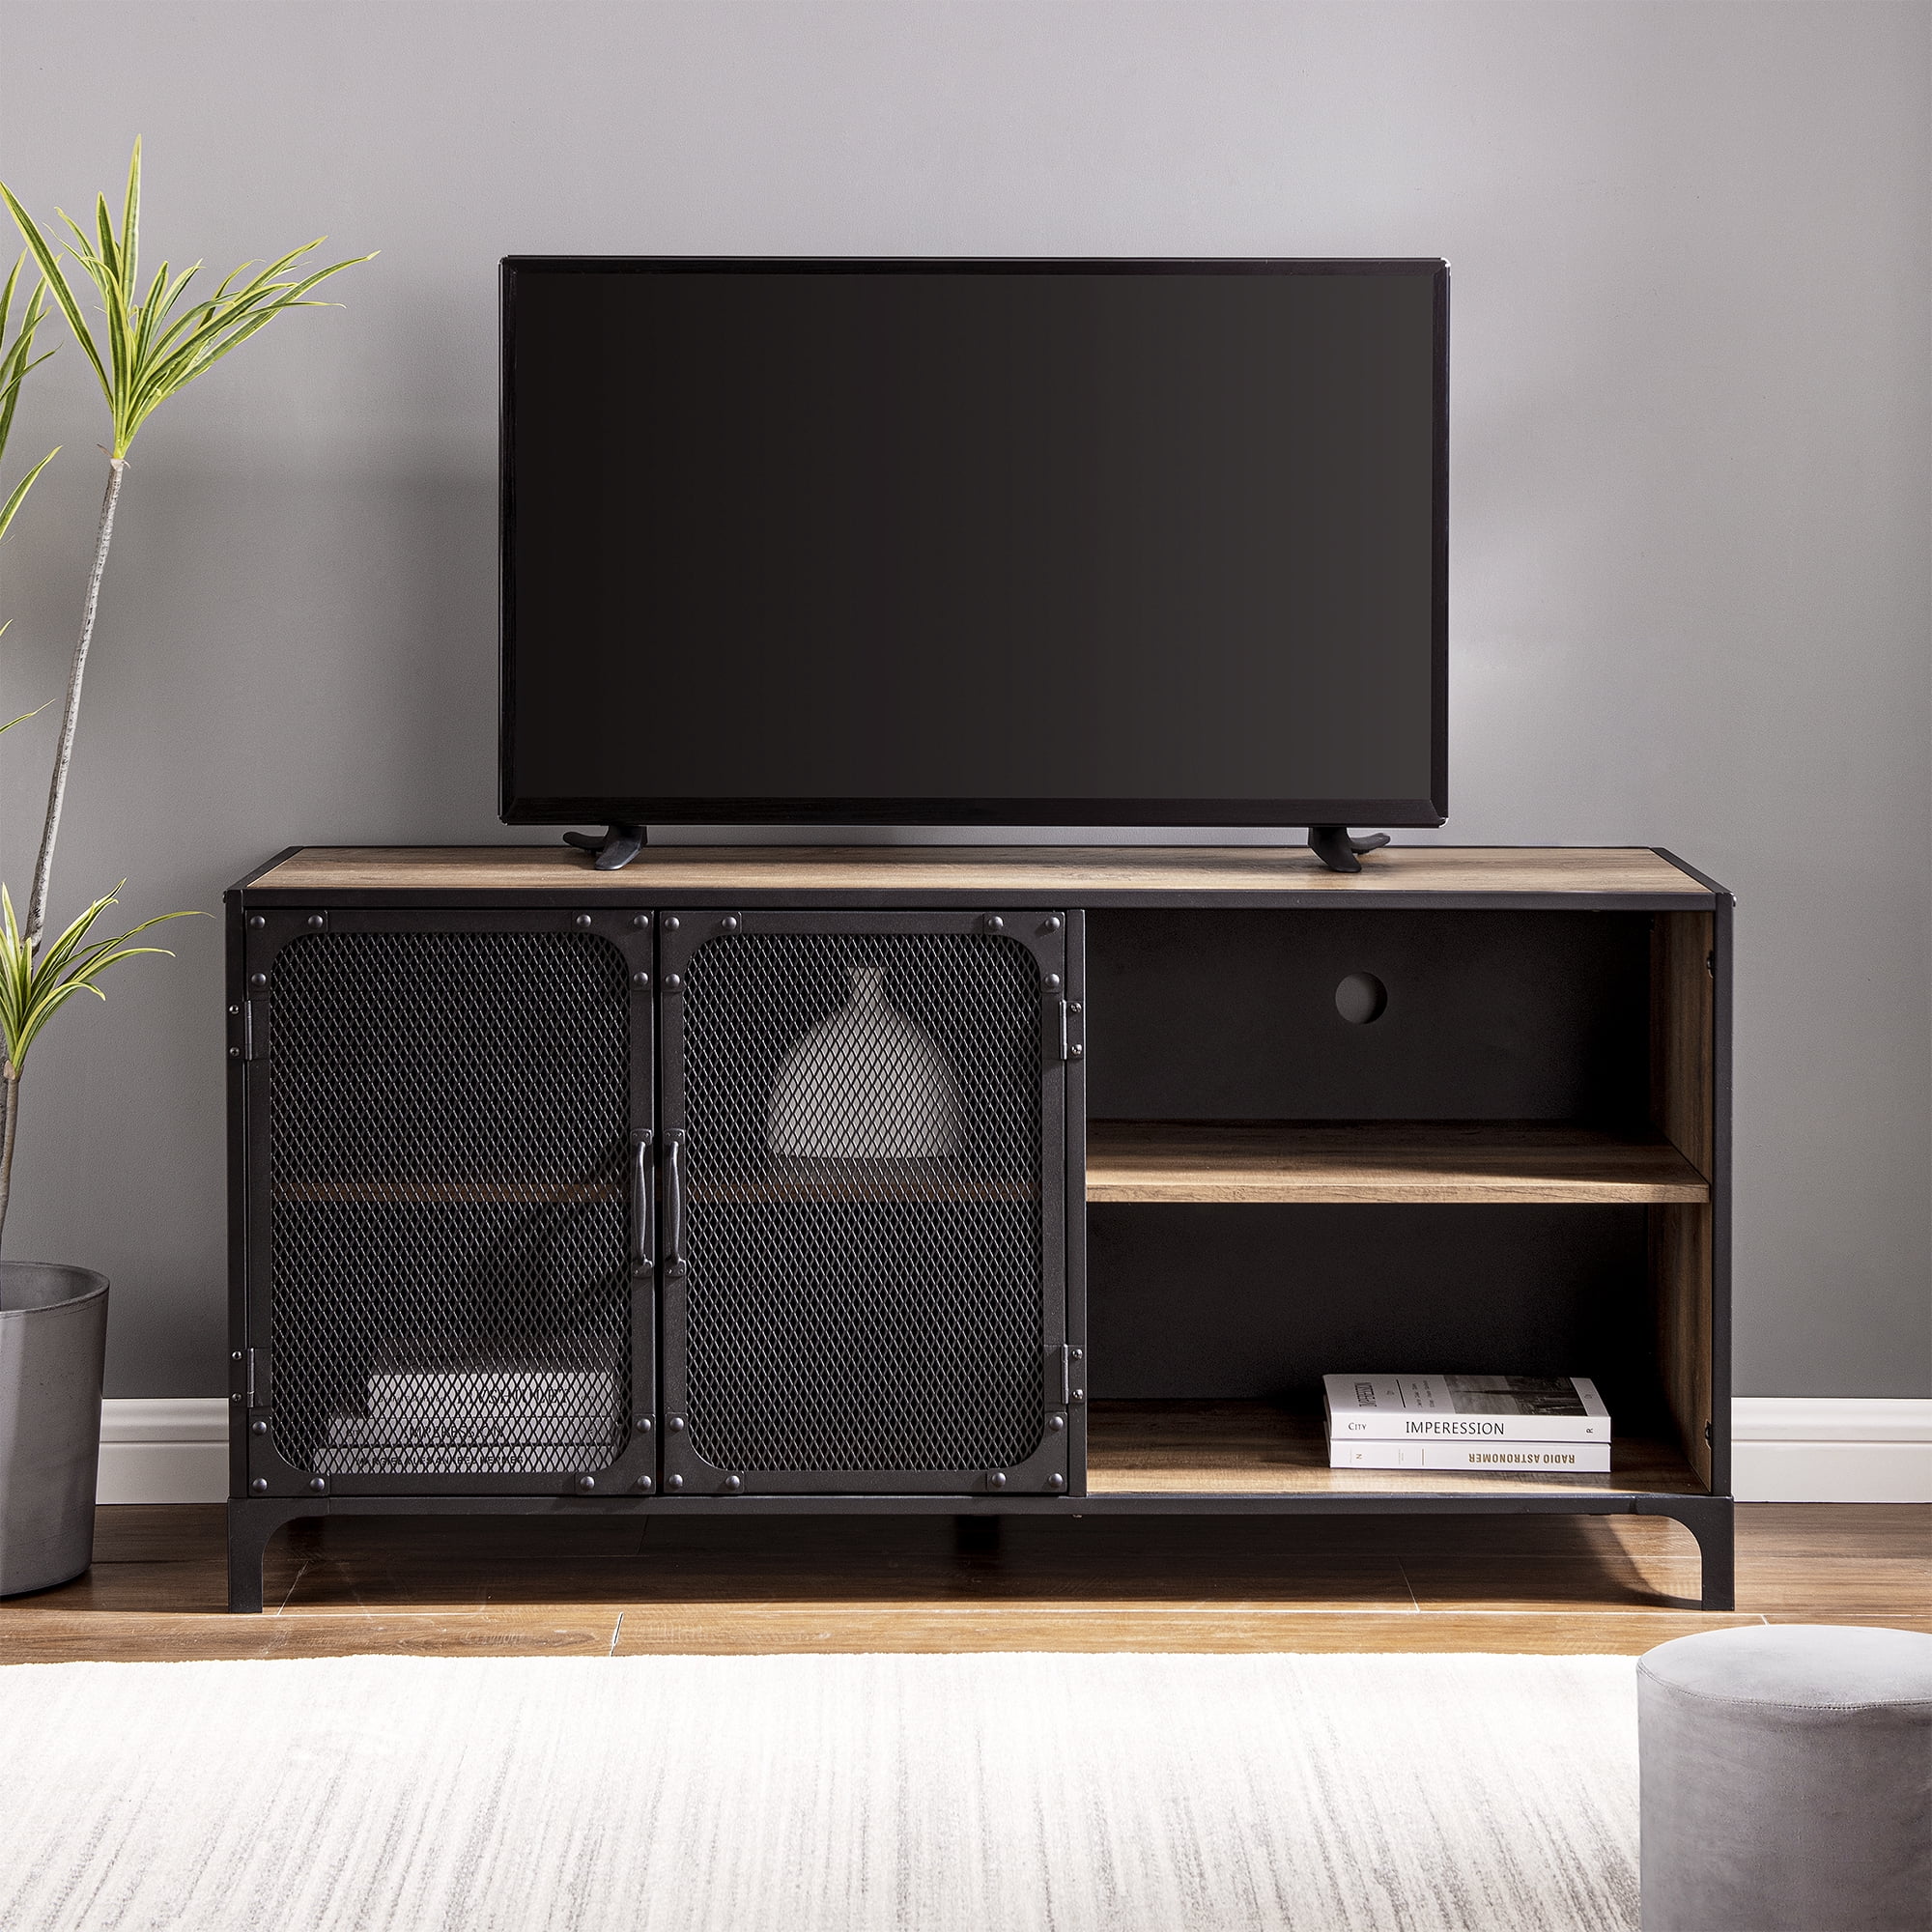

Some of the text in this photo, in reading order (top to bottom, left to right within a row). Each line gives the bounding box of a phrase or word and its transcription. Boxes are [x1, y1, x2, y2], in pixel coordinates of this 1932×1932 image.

[1406, 1421, 1505, 1435] IMPERESSION
[1468, 1453, 1576, 1463] RADIO ASTRONOMER
